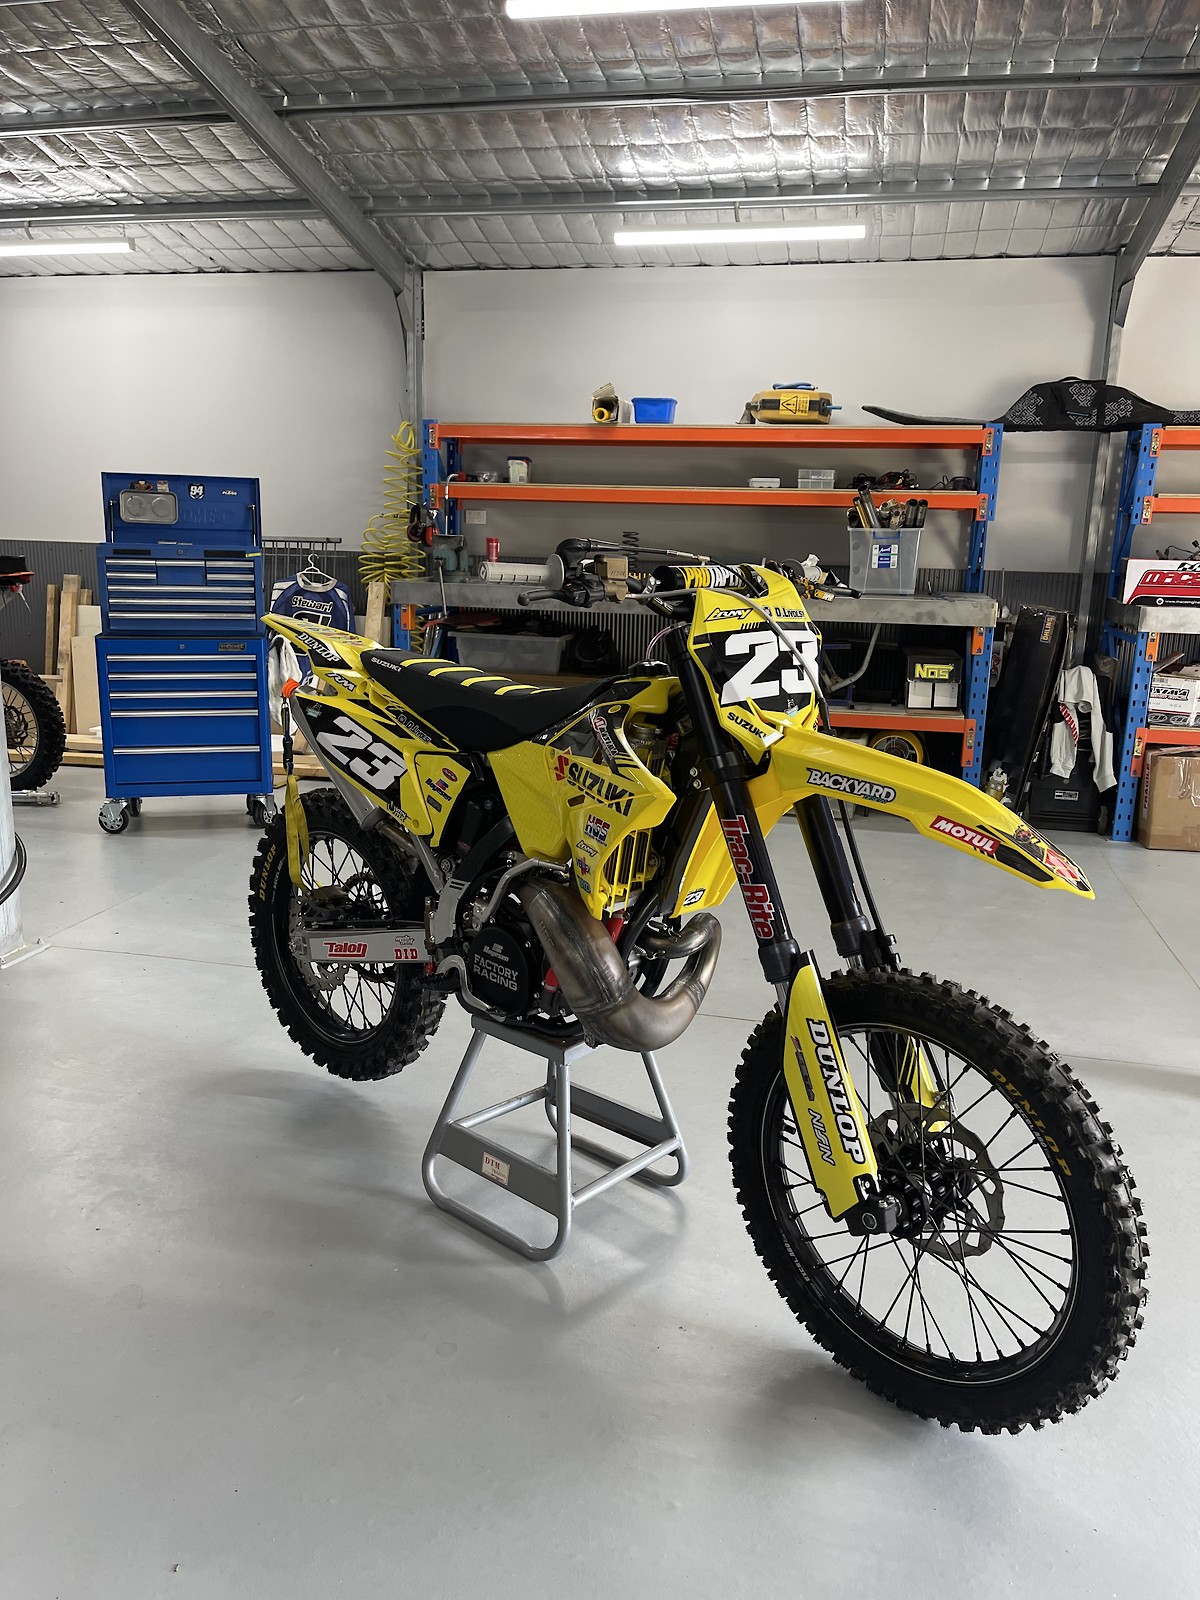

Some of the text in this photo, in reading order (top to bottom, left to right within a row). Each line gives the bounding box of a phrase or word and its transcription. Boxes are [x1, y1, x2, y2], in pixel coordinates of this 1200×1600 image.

[190, 485, 204, 496] 94
[1140, 571, 1200, 586] MAC
[292, 595, 333, 613] Stewart
[297, 631, 341, 663] DUNLOP
[370, 656, 402, 673] SUZUKI
[720, 630, 819, 705] 23
[915, 663, 954, 679] NOS
[325, 672, 356, 692] RM
[727, 711, 767, 739] SUZUKI
[316, 716, 407, 790] 23
[567, 762, 635, 817] SUZUKI
[806, 767, 896, 803] BACKYARD
[585, 814, 611, 841] HGS
[933, 819, 995, 853] MOTUL
[259, 844, 276, 902] DUNLOP
[720, 814, 775, 939] Trac-Rite
[684, 890, 704, 906] 23
[324, 942, 368, 959] Talon
[473, 964, 518, 991] RACING
[474, 953, 518, 981] FACTORY
[806, 1017, 866, 1165] DUNLOP
[990, 1068, 1072, 1177] DUNLOP
[485, 1156, 500, 1170] DTM
